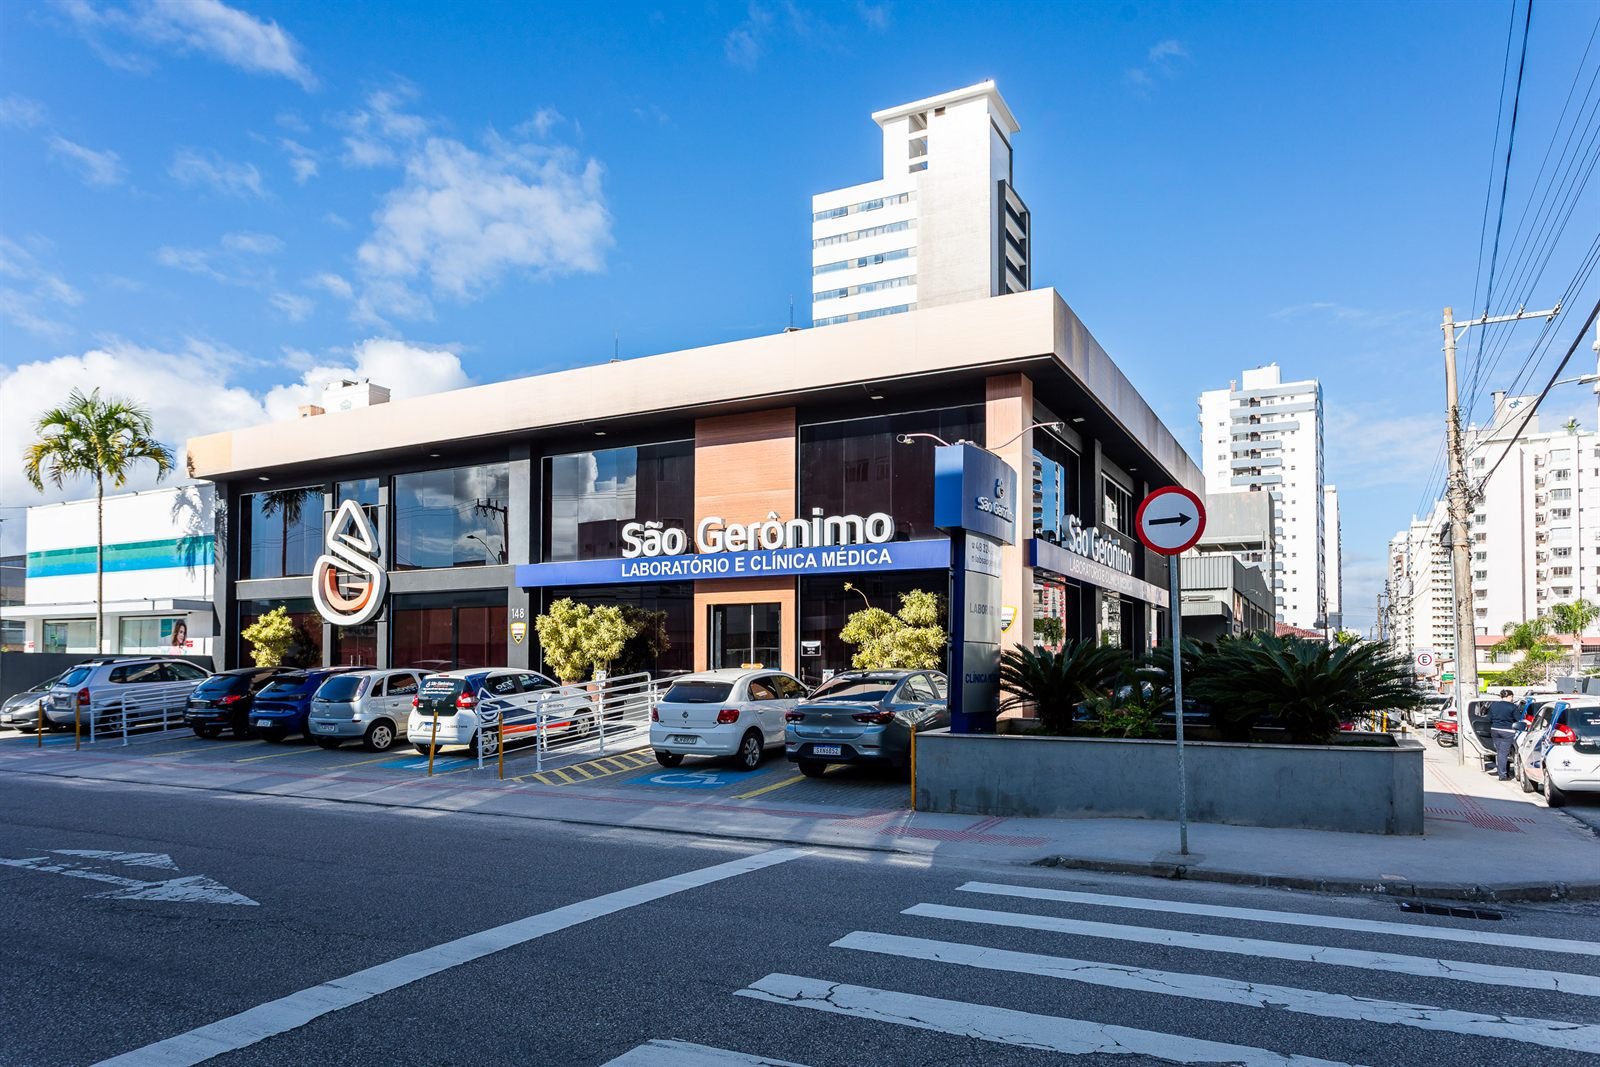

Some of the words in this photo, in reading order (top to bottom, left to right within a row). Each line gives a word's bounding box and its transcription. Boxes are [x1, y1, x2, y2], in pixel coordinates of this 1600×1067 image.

[621, 520, 687, 559] São
[696, 507, 894, 554] Gerônimo
[1067, 513, 1089, 558] São
[1092, 526, 1133, 576] Gerônimo
[621, 556, 729, 578] LABORATÓRIO
[735, 557, 745, 572] E
[750, 551, 818, 570] CLÍNICA
[822, 546, 892, 568] MÉDICA
[511, 607, 525, 619] 148
[1421, 655, 1428, 664] E
